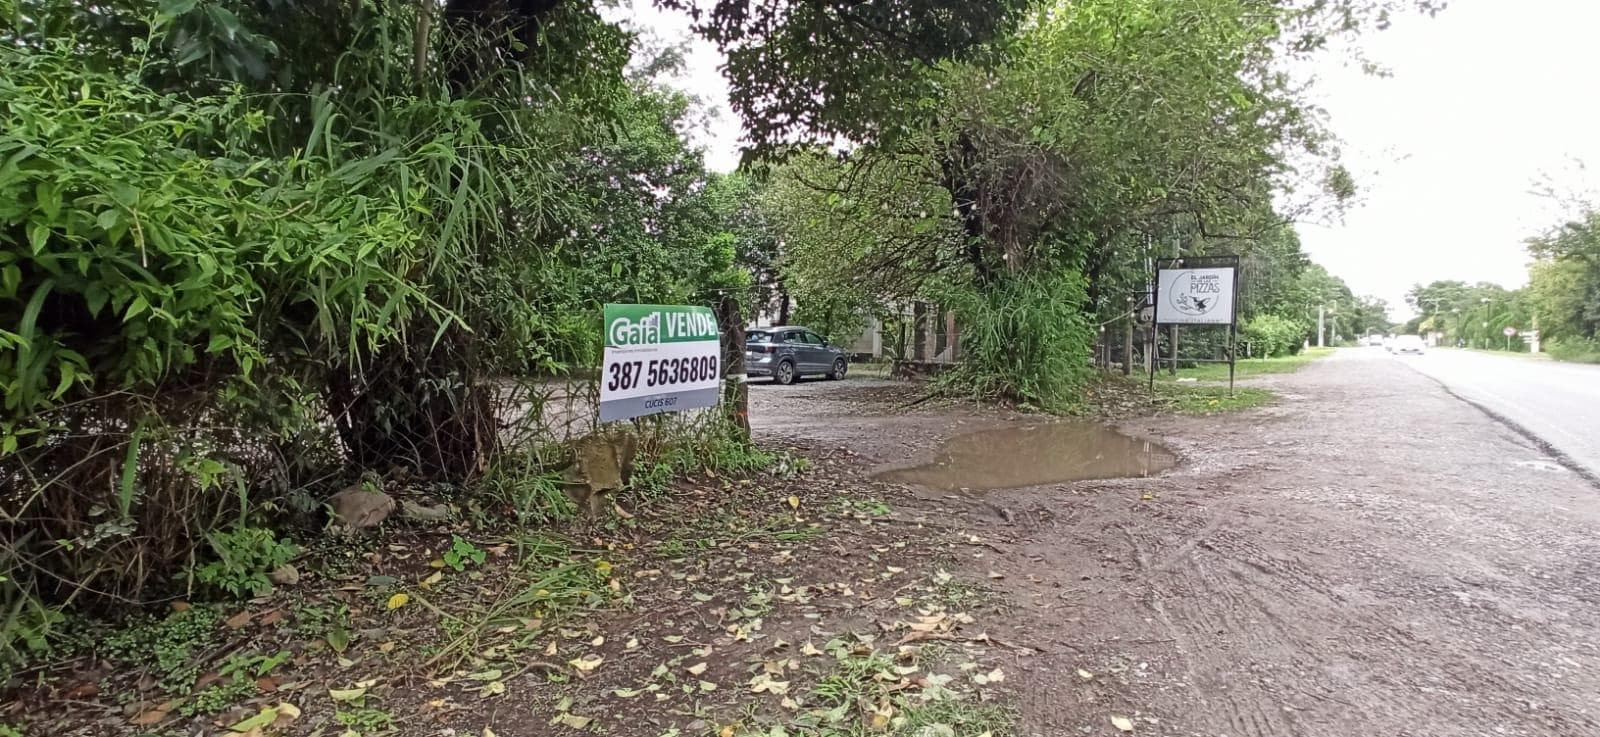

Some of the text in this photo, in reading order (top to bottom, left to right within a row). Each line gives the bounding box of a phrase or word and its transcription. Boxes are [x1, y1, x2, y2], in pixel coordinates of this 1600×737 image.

[1190, 283, 1220, 293] PIZZAS
[611, 312, 717, 346] Gaia VENDE
[607, 355, 717, 392] 387 5636809
[645, 397, 677, 409] CUCIS 607
